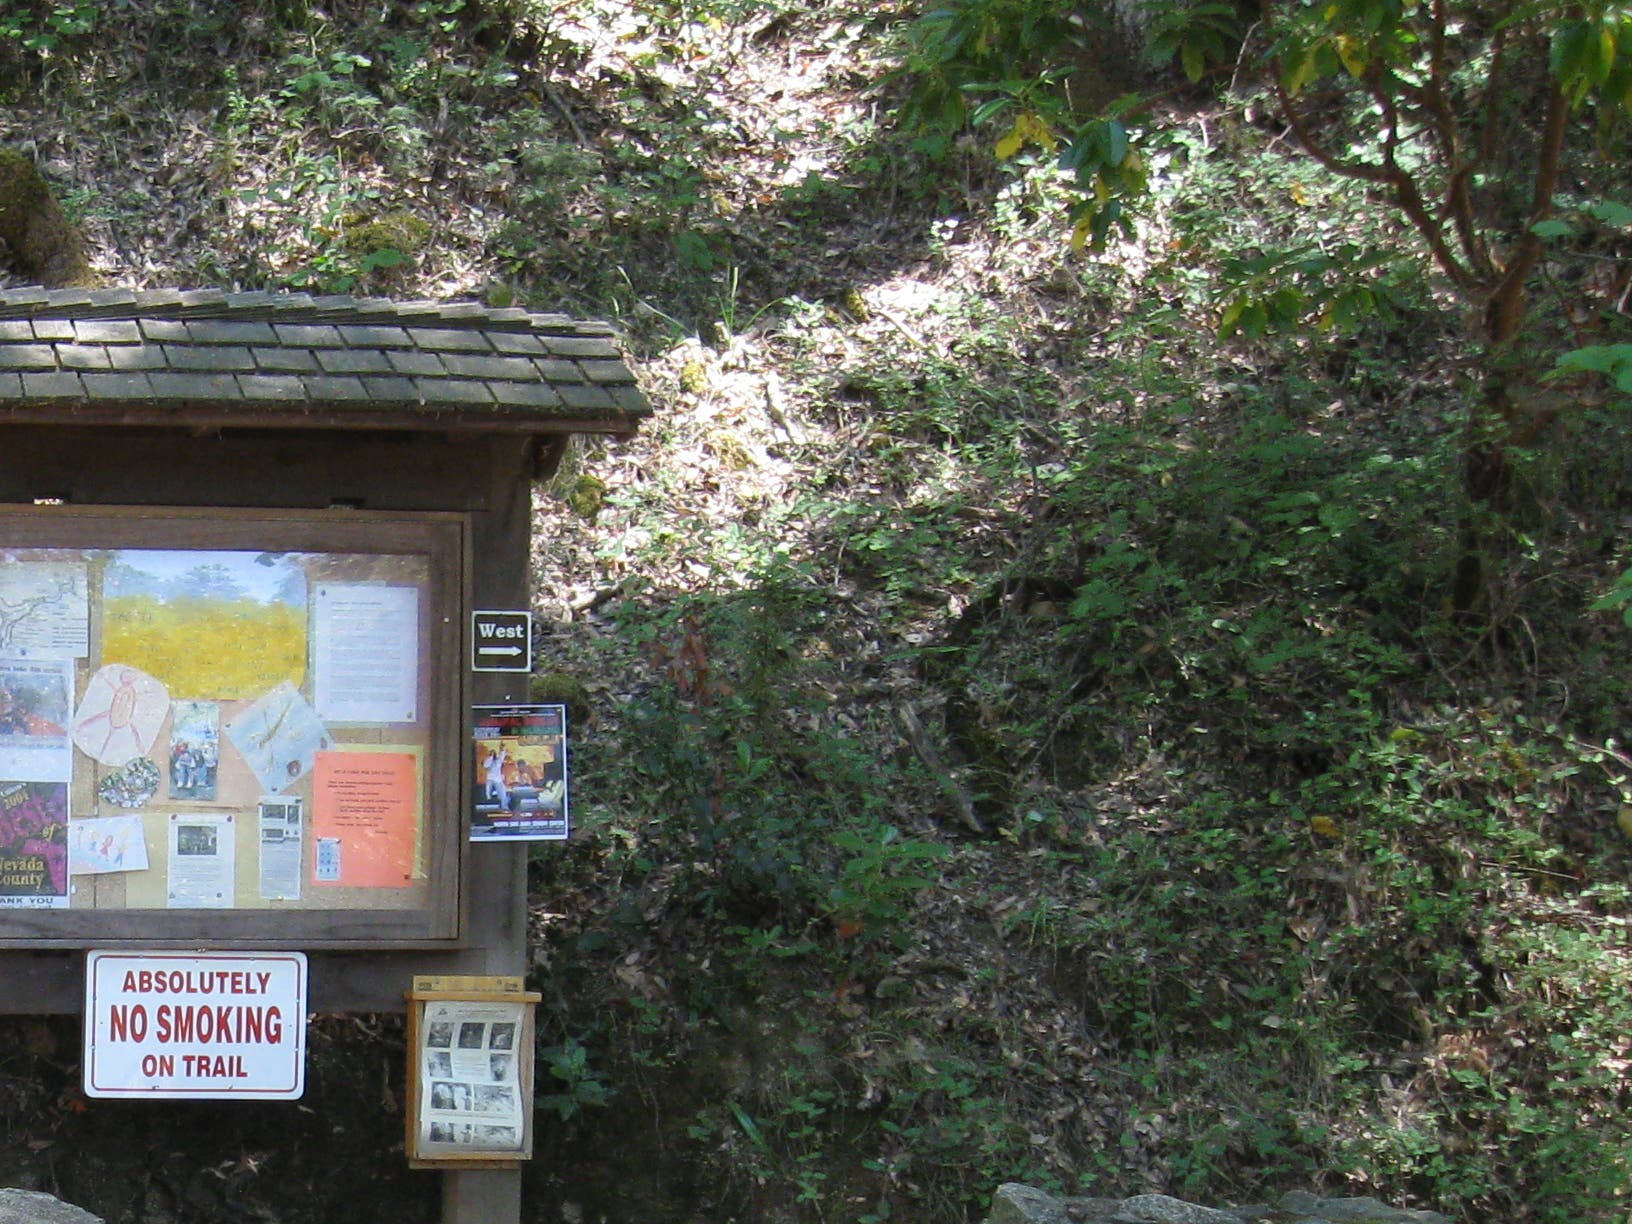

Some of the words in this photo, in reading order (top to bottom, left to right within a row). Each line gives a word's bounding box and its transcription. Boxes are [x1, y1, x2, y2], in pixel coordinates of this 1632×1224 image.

[478, 623, 524, 638] West
[29, 896, 54, 905] YOU
[122, 970, 272, 994] ABSOLUTELY
[110, 1004, 148, 1043] NO
[156, 1005, 282, 1044] SMOKING
[142, 1055, 174, 1077] ON
[182, 1055, 248, 1078] TRAIL
